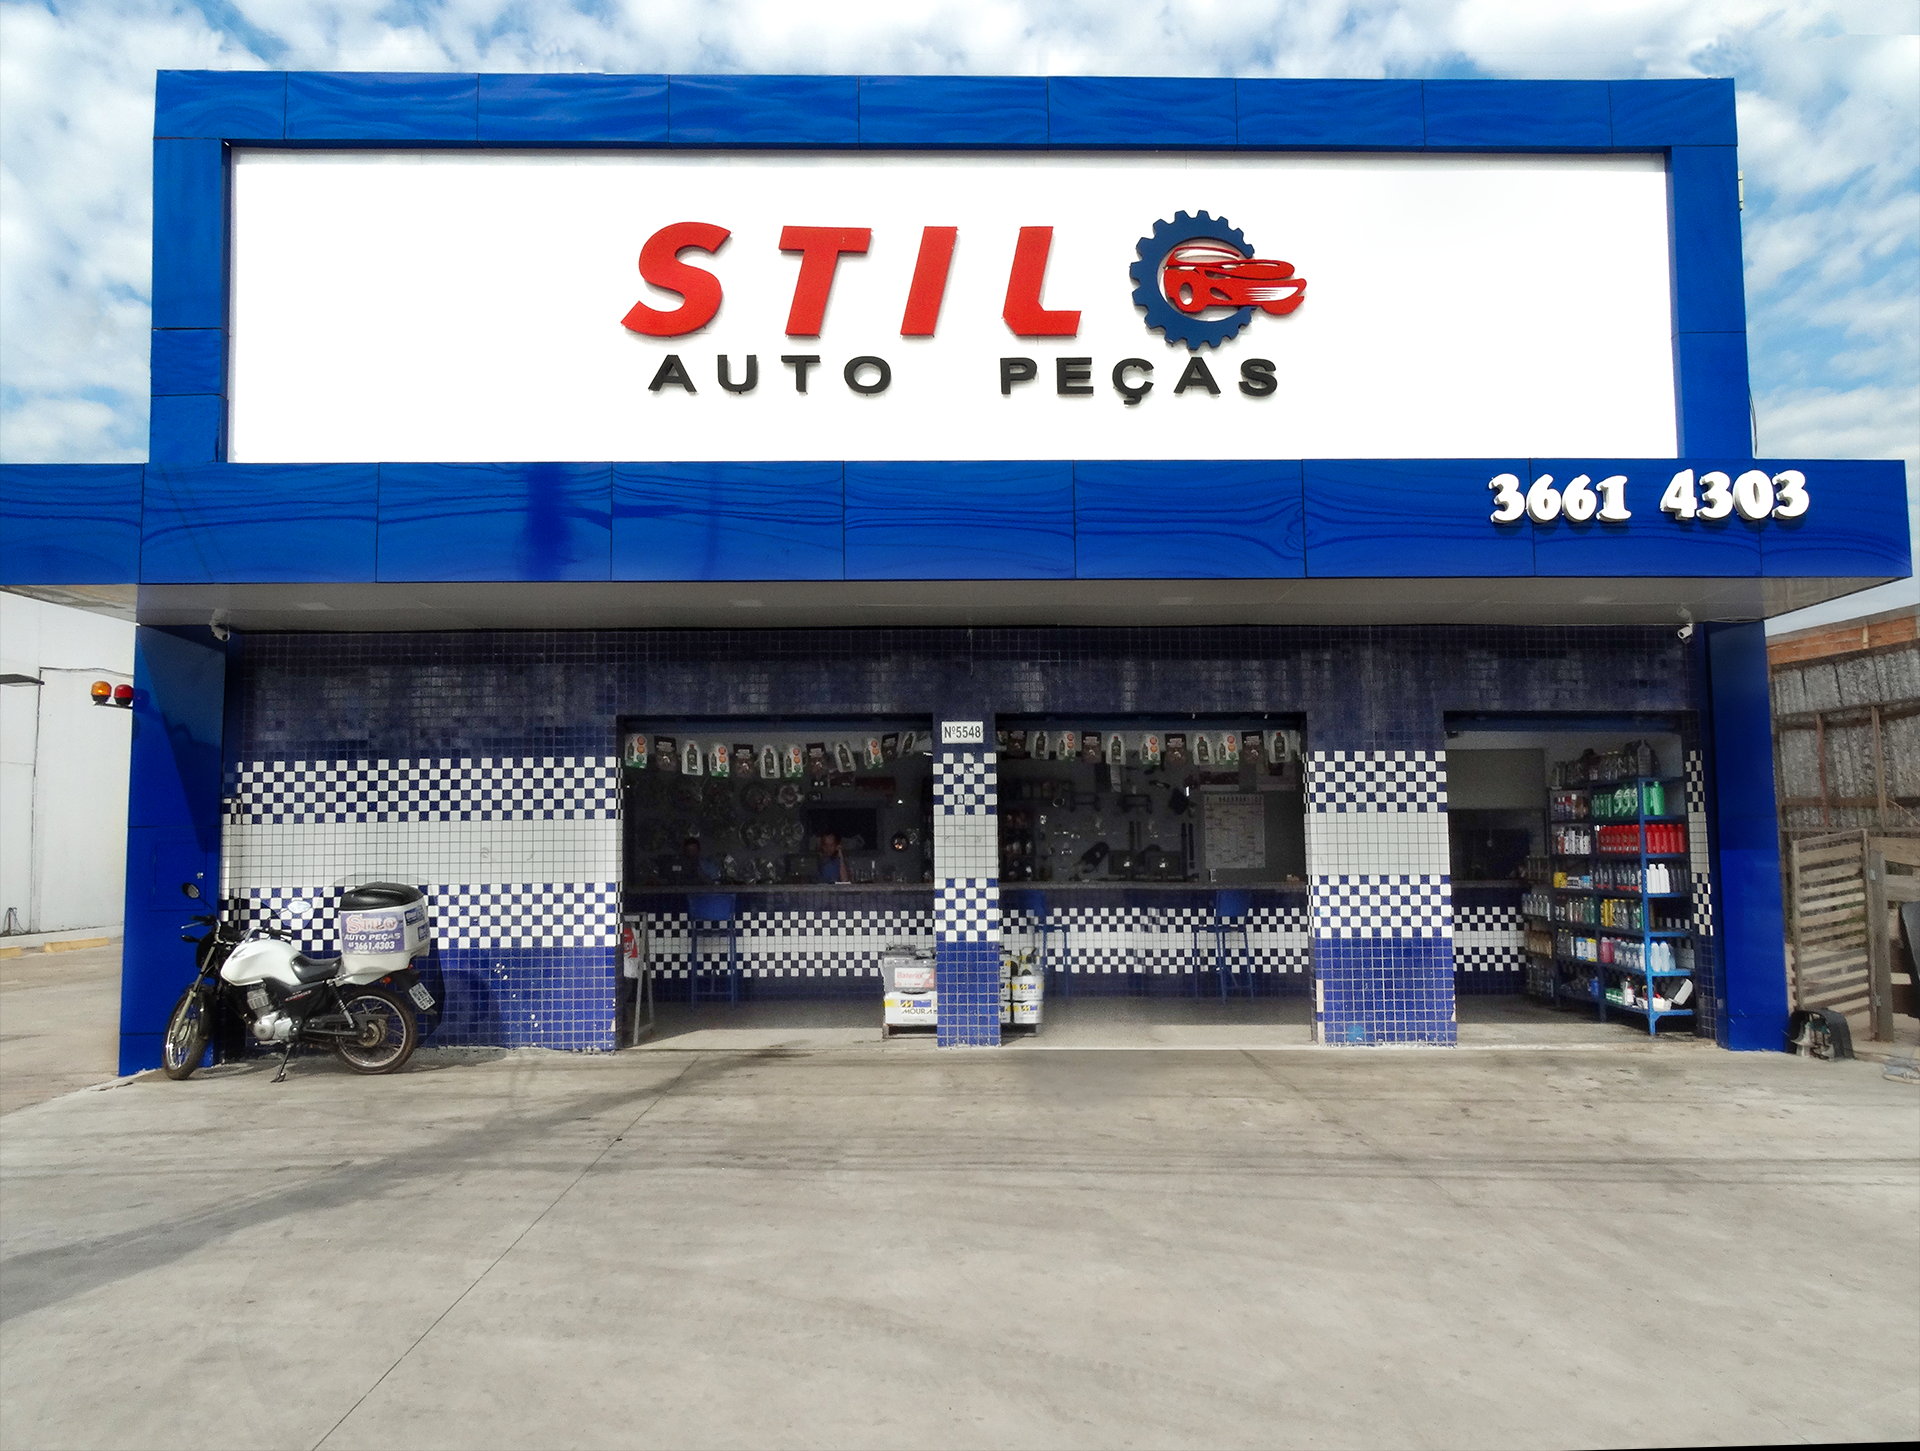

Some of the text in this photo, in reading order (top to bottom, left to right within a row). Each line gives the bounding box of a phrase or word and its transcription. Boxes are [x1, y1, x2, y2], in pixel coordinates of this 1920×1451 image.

[648, 354, 1278, 406] AUTO PEÇAS
[1488, 468, 1811, 523] 3661 4303
[344, 932, 401, 942] AUTO PEÇAS
[354, 940, 395, 950] 3661.4303
[897, 971, 924, 979] Baterax
